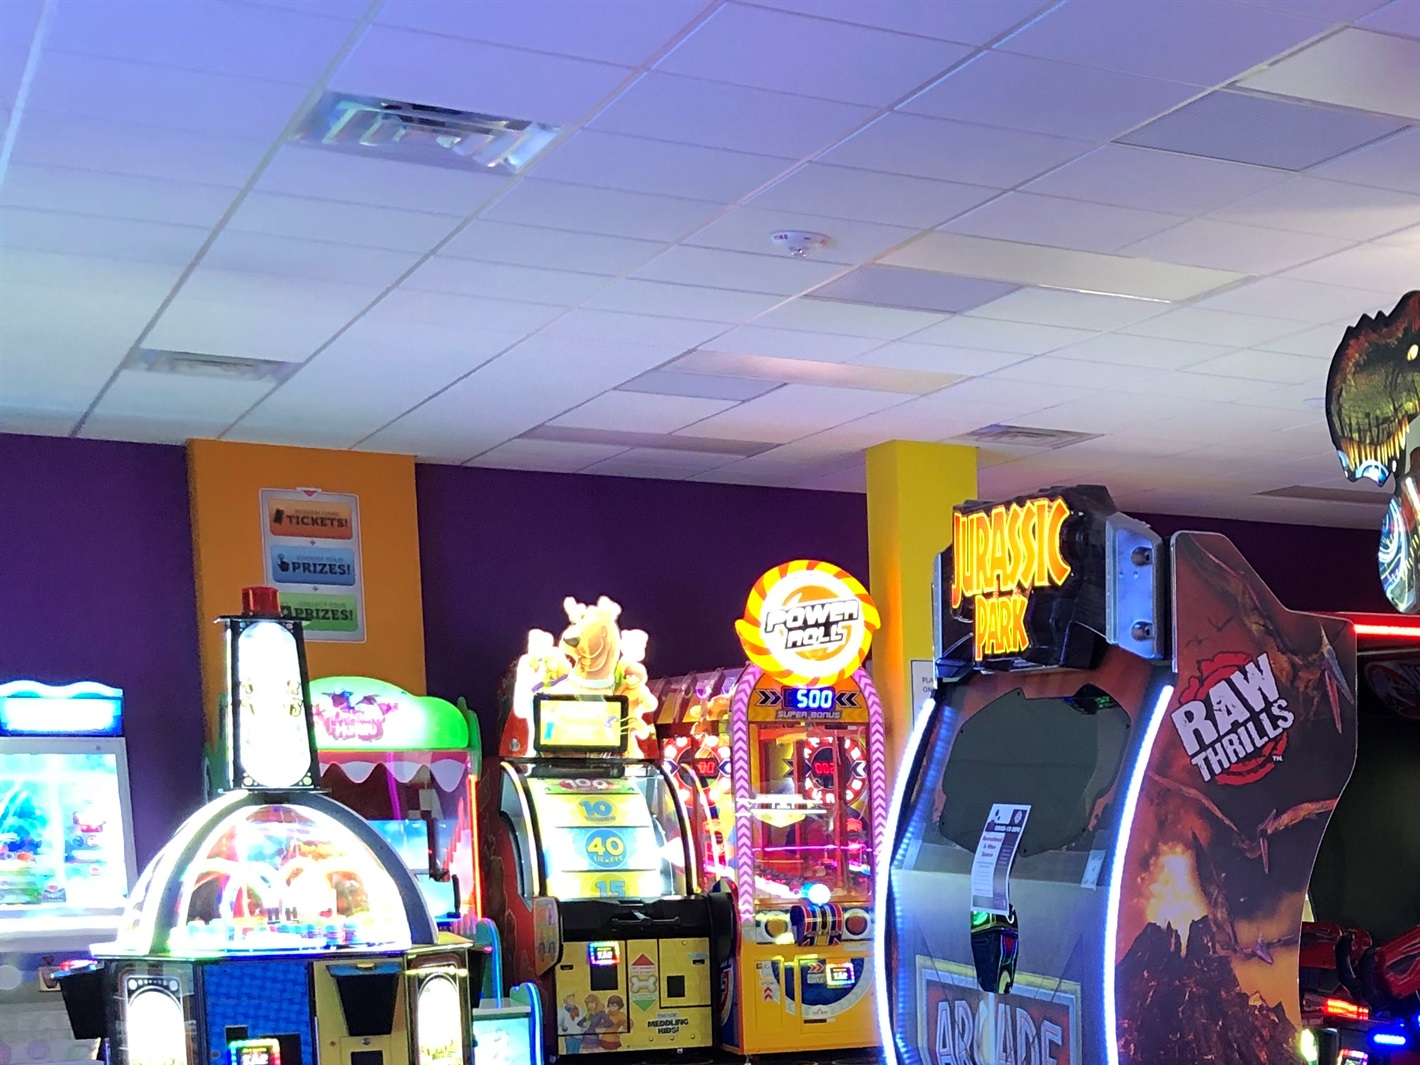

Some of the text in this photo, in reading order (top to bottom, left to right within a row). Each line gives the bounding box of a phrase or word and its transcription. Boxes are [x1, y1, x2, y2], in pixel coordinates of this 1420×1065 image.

[286, 514, 348, 529] TICKETS!
[952, 496, 1071, 609] JURASSIC
[292, 561, 351, 576] PRIZES!
[295, 607, 353, 621] PRIZES!
[764, 599, 859, 634] POWER
[785, 623, 844, 650] ROLL
[974, 595, 1029, 661] PARK
[796, 689, 833, 708] 500
[1171, 652, 1279, 756] RAW
[777, 710, 841, 719] SUPER BONUS
[1191, 699, 1295, 782] THRILLS
[580, 800, 613, 816] 10
[586, 837, 624, 856] 40
[595, 880, 626, 898] 15
[647, 1018, 689, 1028] MEDDLING
[658, 1027, 679, 1035] KIDS!
